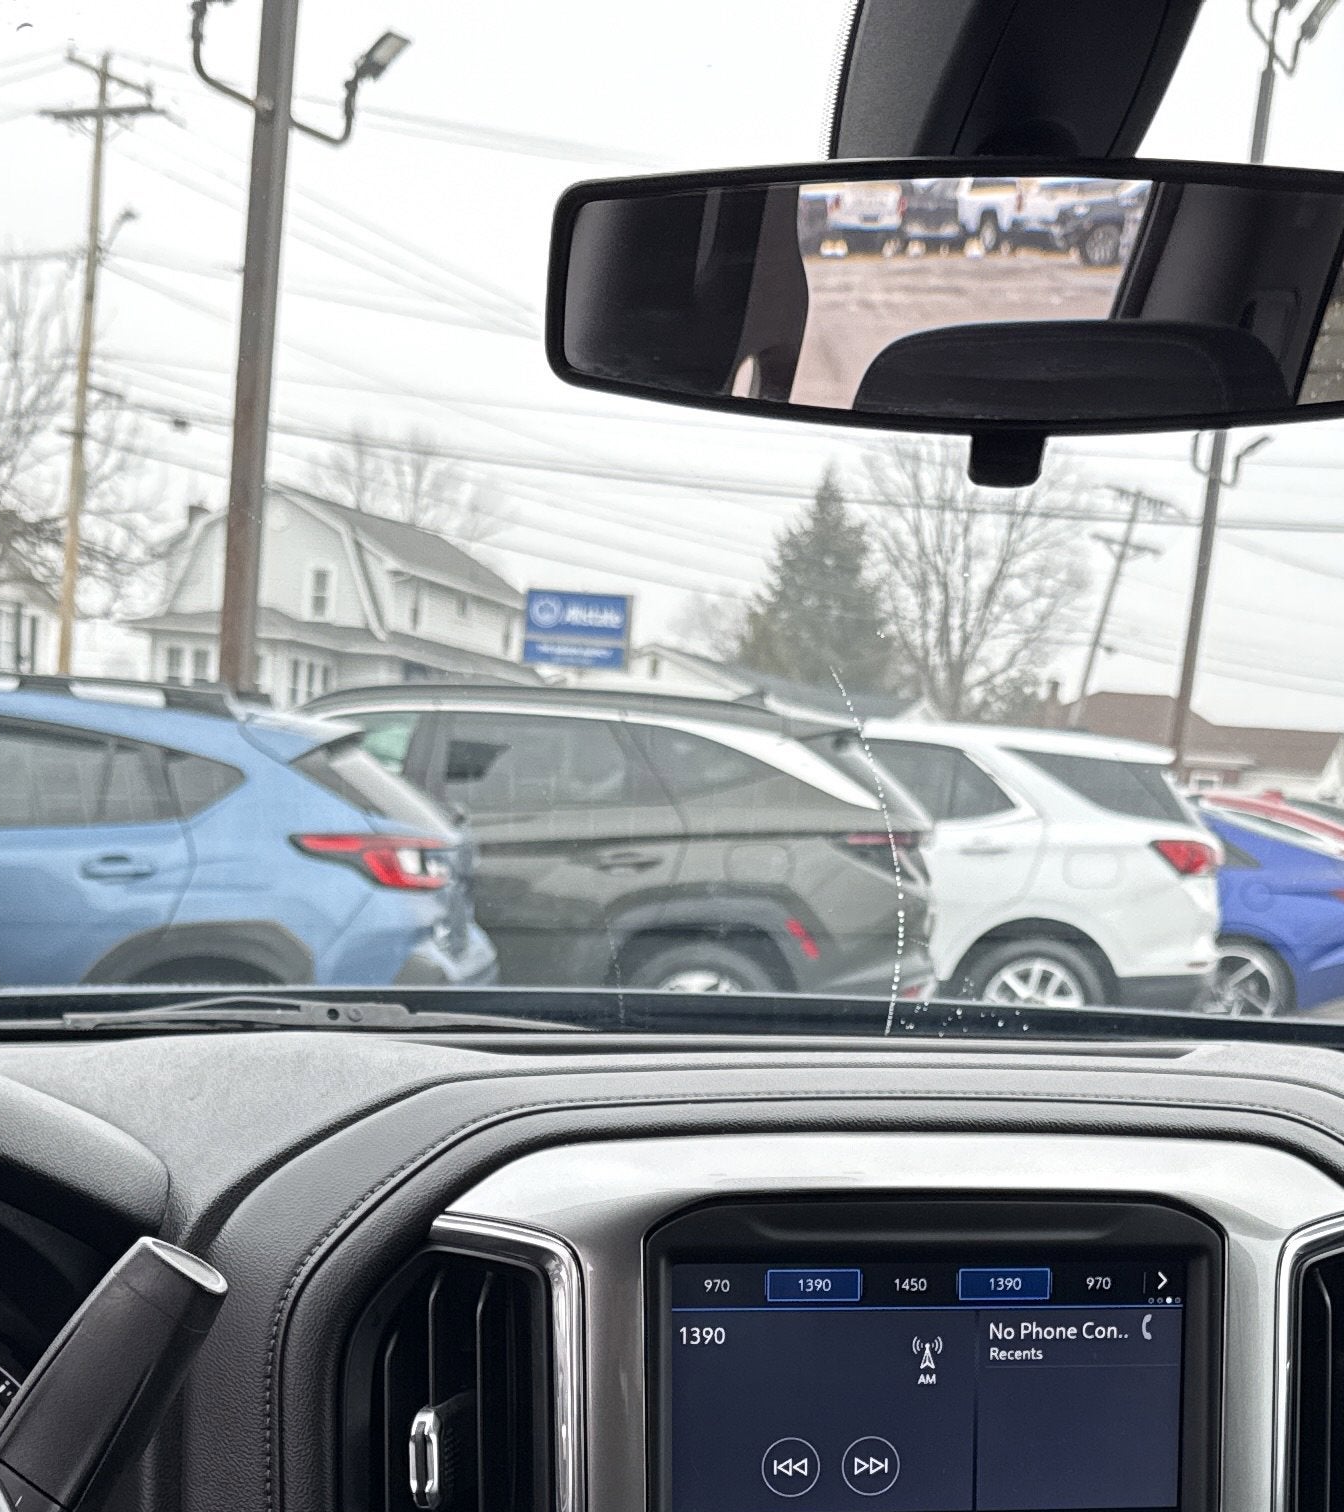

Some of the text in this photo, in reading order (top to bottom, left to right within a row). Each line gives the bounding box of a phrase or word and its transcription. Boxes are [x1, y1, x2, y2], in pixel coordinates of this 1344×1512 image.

[704, 1276, 1111, 1293] 970 1390 1450 1390 970
[679, 1327, 726, 1345] 1390
[989, 1322, 1015, 1340] No
[1020, 1321, 1077, 1339] Phone
[989, 1347, 1043, 1361] Recents
[917, 1373, 937, 1385] AM
